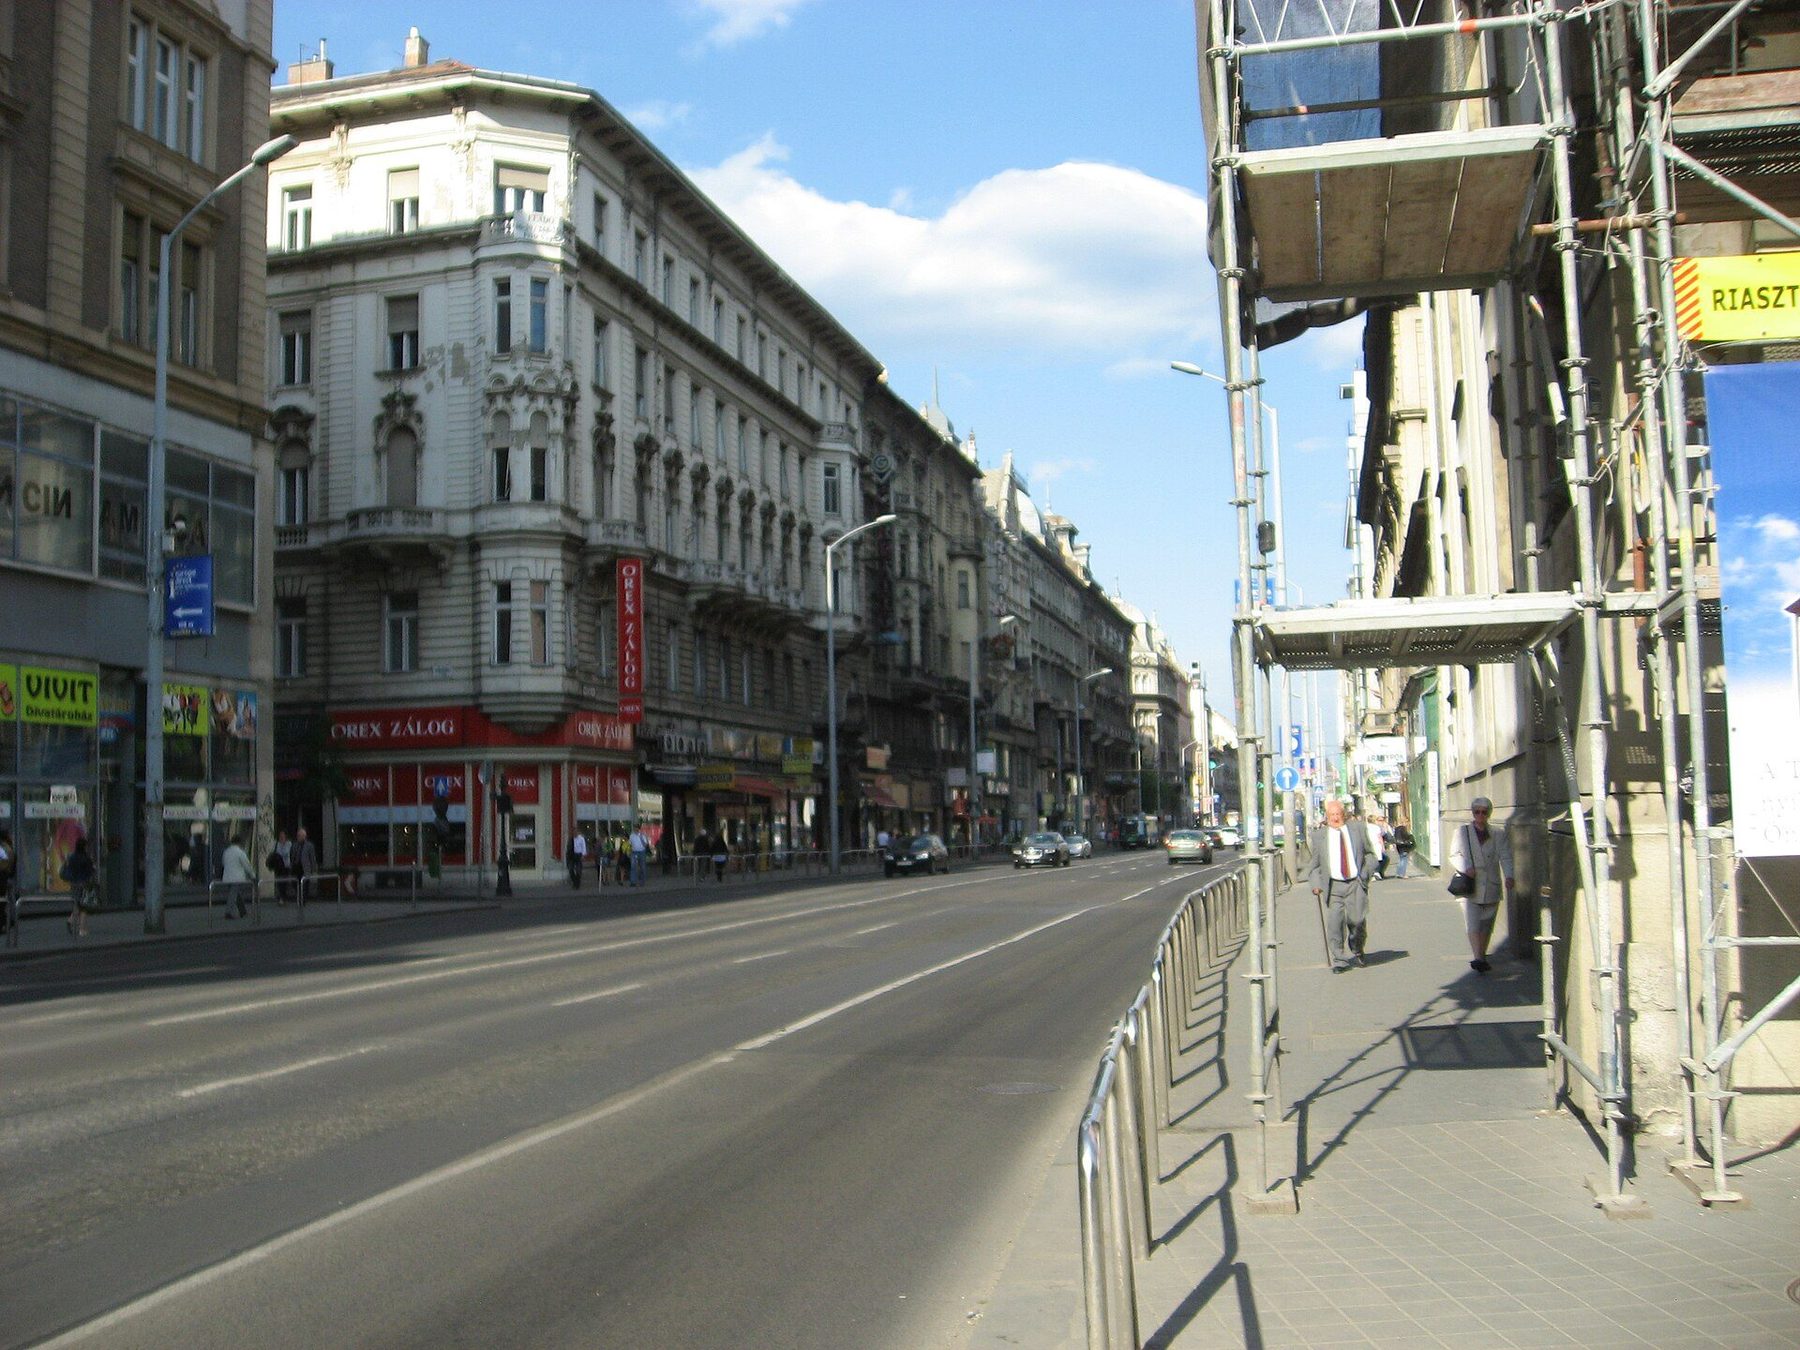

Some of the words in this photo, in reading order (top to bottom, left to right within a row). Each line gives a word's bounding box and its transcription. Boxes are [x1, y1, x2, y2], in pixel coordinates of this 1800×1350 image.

[1712, 285, 1800, 311] RIASZT
[622, 565, 636, 614] OREX
[624, 622, 636, 688] ZÁLOG
[25, 674, 94, 703] VIVIT
[331, 720, 382, 739] OREX
[390, 716, 455, 737] ZÁLOG
[577, 721, 602, 738] OREX
[507, 776, 536, 788] OREX
